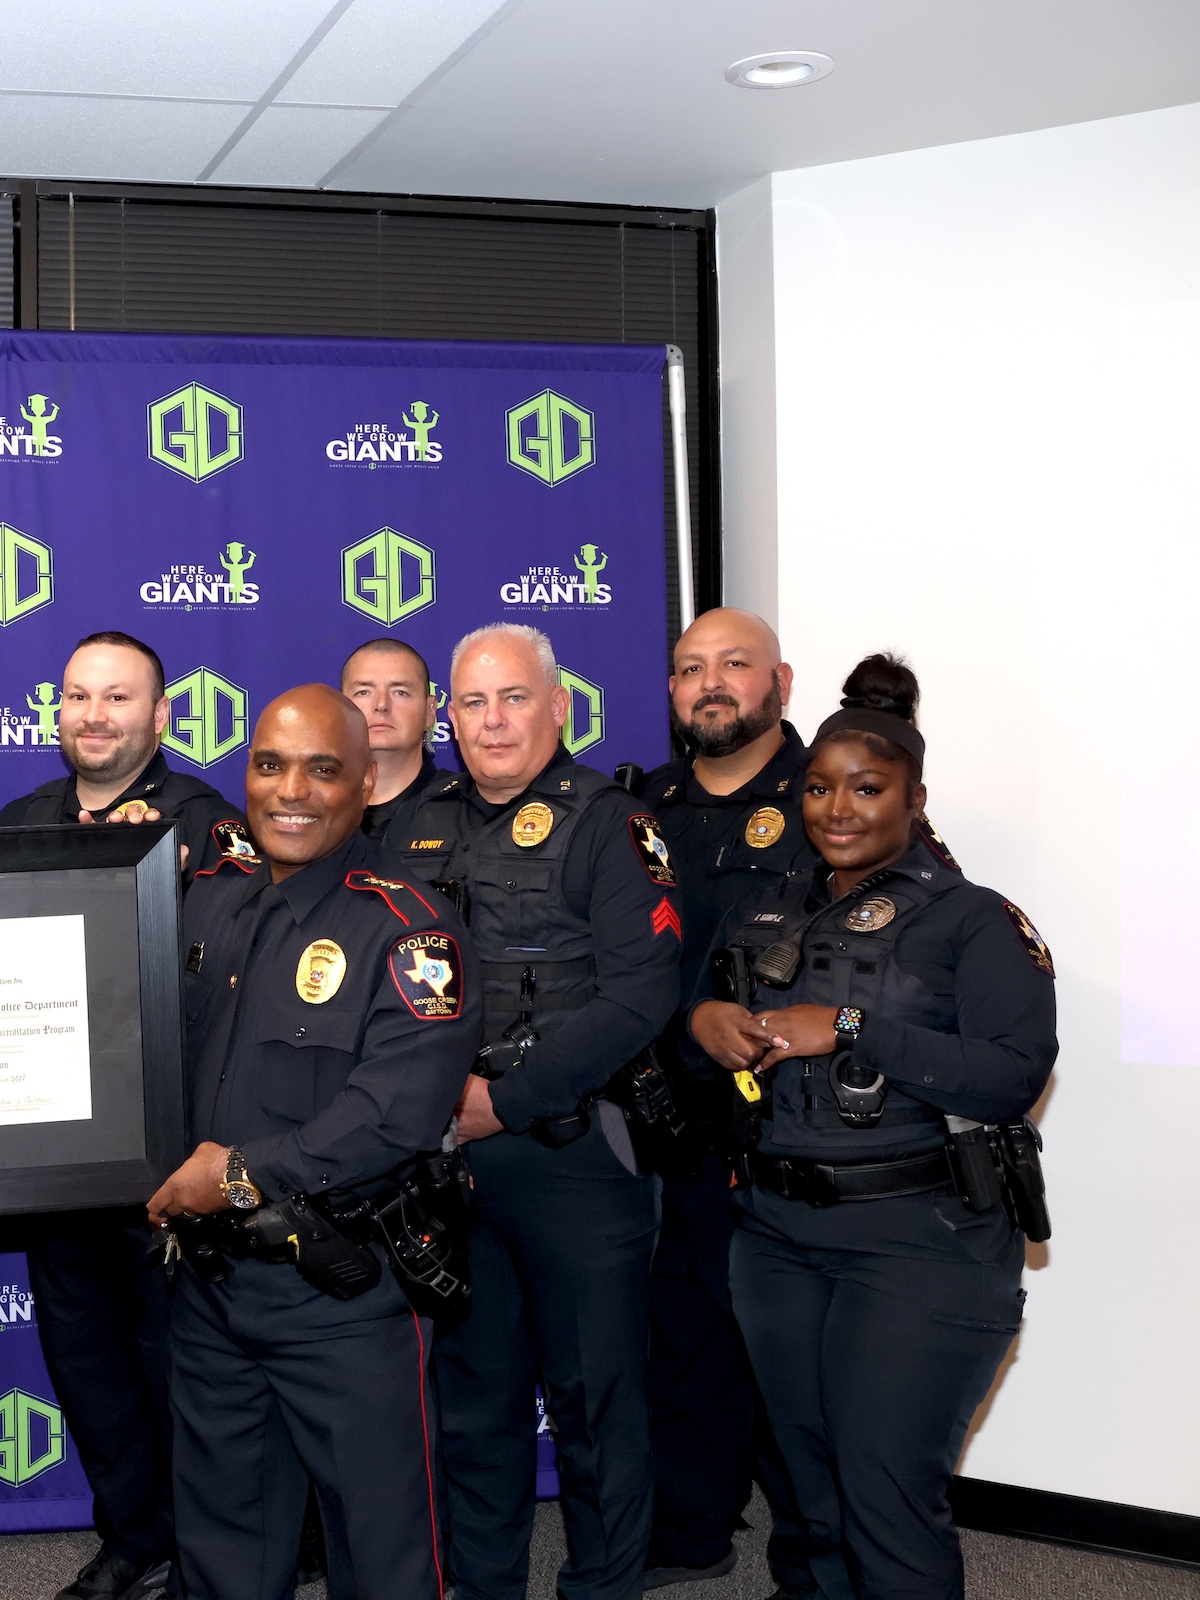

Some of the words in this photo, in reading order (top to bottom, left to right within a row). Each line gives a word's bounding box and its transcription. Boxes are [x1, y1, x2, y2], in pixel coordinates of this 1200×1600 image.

[355, 424, 389, 433] HERE,
[347, 433, 363, 441] WE
[370, 433, 406, 441] GROW
[326, 440, 442, 462] GIANTS
[171, 566, 206, 574] HERE,
[529, 567, 561, 576] HERE,
[162, 574, 179, 582] WE
[186, 574, 223, 583] GROW
[520, 576, 537, 584] WE
[543, 576, 578, 584] GROW
[140, 582, 259, 603] GIANTS
[500, 583, 612, 603] GIANTS
[411, 841, 418, 849] K.
[418, 840, 444, 849] DOWDY
[398, 936, 448, 954] POLICE
[24, 1000, 78, 1010] Department
[413, 997, 437, 1005] GOOSE
[43, 1025, 75, 1035] Program
